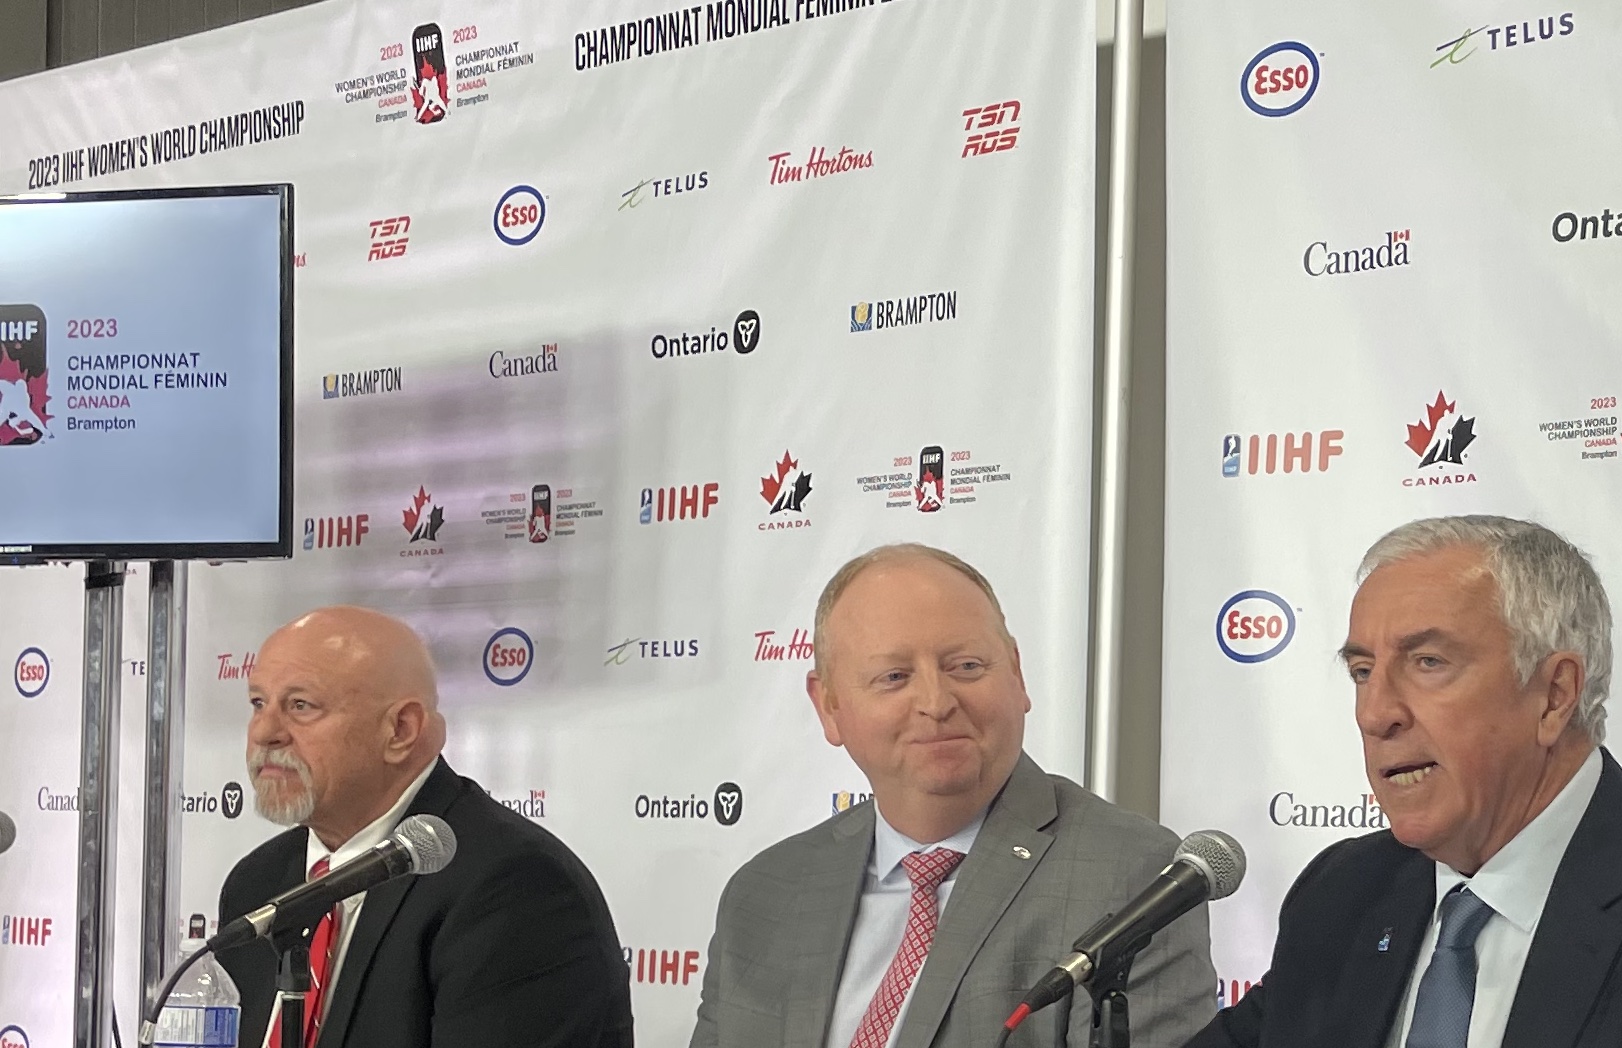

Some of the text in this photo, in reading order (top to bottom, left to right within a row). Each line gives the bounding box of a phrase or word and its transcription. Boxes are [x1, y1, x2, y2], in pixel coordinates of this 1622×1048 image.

[415, 33, 439, 52] IIHF
[452, 25, 478, 44] 2023
[575, 6, 702, 71] CHAMPIONNAT
[1487, 13, 1575, 50] TELUS
[380, 43, 404, 61] 2023
[455, 41, 519, 66] CHAMPIONNAT
[456, 53, 534, 81] MONDIAL FÉMININ
[335, 68, 406, 93] WOMEN'S WORLD
[345, 81, 408, 104] CHAMPIONSHIP
[456, 78, 487, 93] CANADA
[1254, 65, 1309, 96] Esso
[378, 94, 407, 109] CANADA
[456, 92, 489, 108] Brampton
[375, 109, 407, 123] Brampton
[962, 99, 1021, 131] TSN
[28, 100, 304, 190] 2023 IIHF WOMEN'S WORLD CHAMPIONSHIP
[961, 127, 1020, 158] RDS
[769, 146, 874, 185] Tim Hortons
[653, 171, 709, 197] TELUS
[369, 215, 411, 238] TSN
[501, 203, 538, 228] Esso
[368, 238, 409, 262] RDS
[1303, 232, 1410, 277] Canada
[876, 291, 957, 330] BRAMPTON
[0, 320, 39, 341] IHF
[67, 318, 118, 339] 2023
[651, 326, 728, 359] Ontario
[67, 352, 199, 371] CHAMPIONNAT
[489, 344, 558, 378] Canada
[67, 369, 227, 391] MONDIAL FÉMININ
[341, 366, 402, 397] BRAMPTON
[67, 395, 130, 409] CANADA
[1590, 397, 1617, 410] 2023
[67, 415, 136, 433] Brampton
[1539, 416, 1617, 432] WOMEN'S WORLD
[1548, 427, 1618, 441] CHAMPIONSHIP
[1248, 430, 1344, 475] IIHF
[1584, 438, 1617, 448] CANADA
[950, 451, 971, 462] 2023
[889, 473, 912, 482] WORLD
[950, 465, 1000, 476] CHAMPIONNAT
[1402, 473, 1477, 487] CANADA
[657, 483, 719, 522] IIHF
[318, 513, 369, 549] IIHF
[758, 518, 812, 531] CANADA
[400, 548, 444, 557] CANADA
[1227, 611, 1282, 641] Esso
[490, 642, 527, 667] Esso
[639, 639, 699, 659] TELUS
[754, 630, 785, 663] Tim
[20, 661, 45, 682] Esso
[217, 654, 240, 680] Tim
[38, 786, 79, 812] Canad
[181, 792, 218, 812] tario
[634, 794, 709, 820] Ontario
[12, 916, 53, 946] IIHF
[637, 949, 700, 986] IIHF
